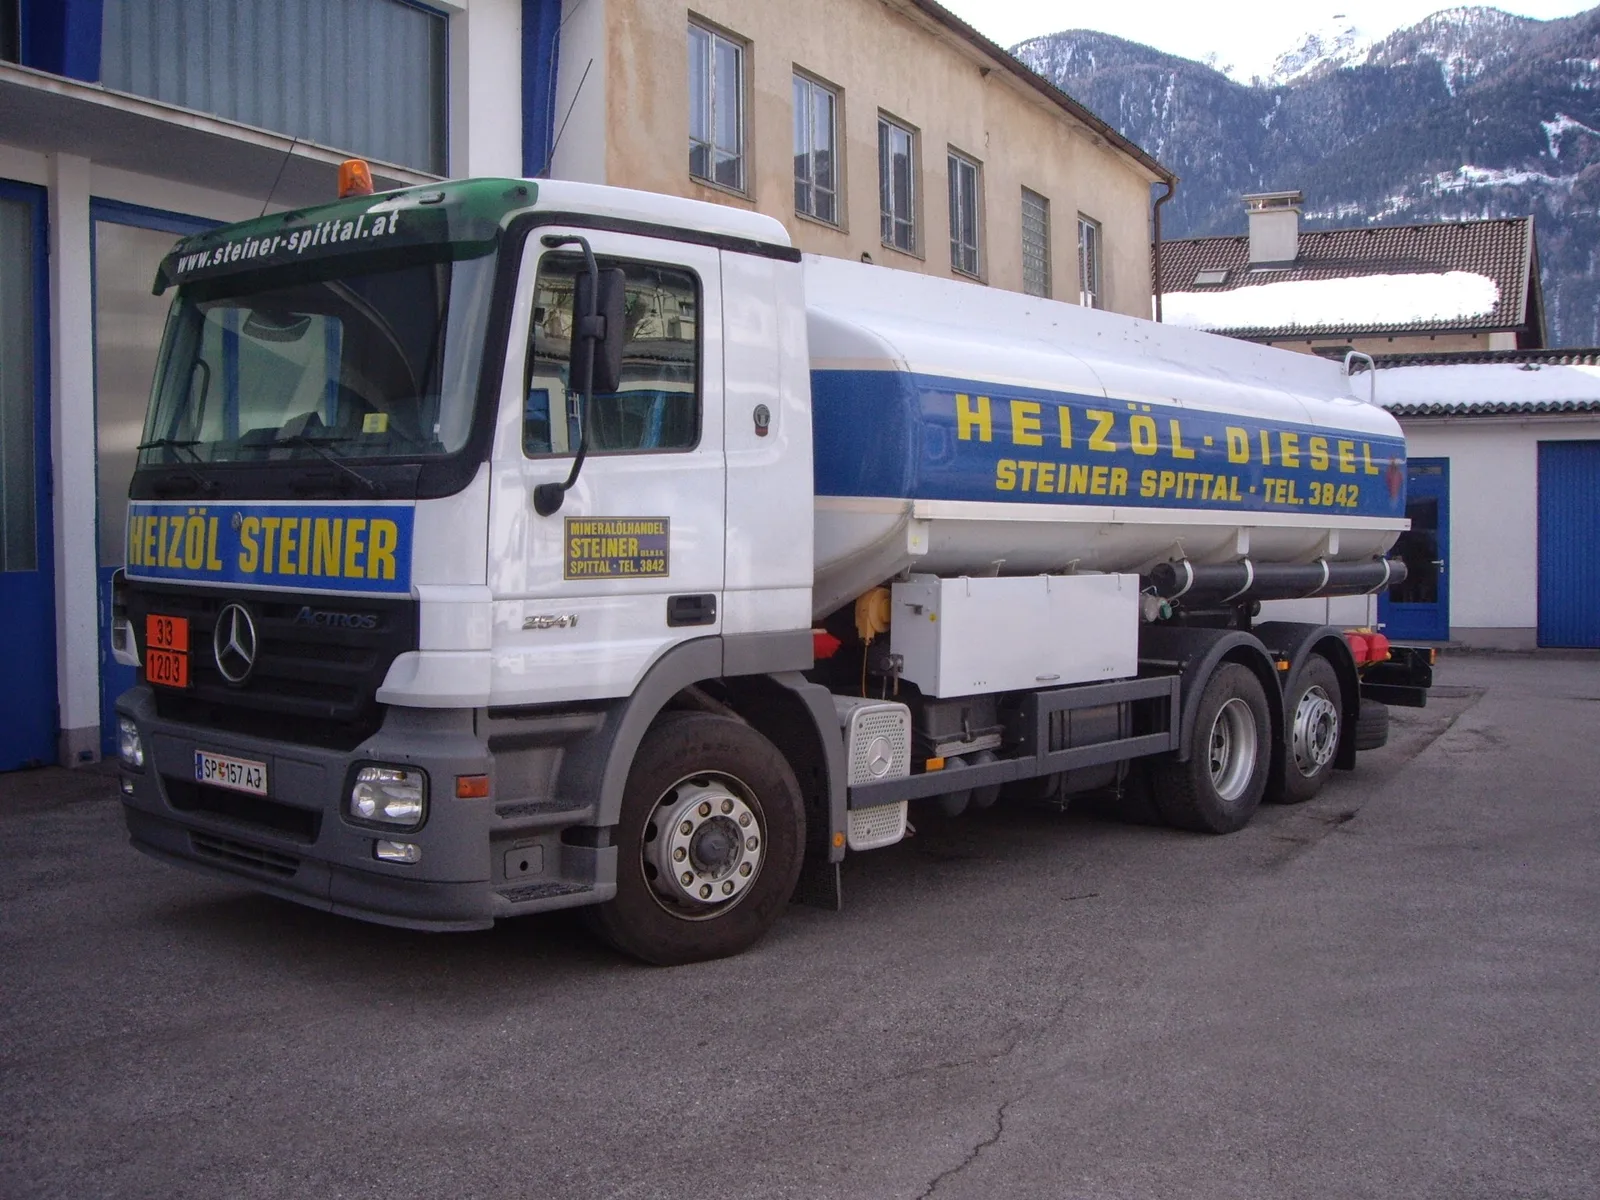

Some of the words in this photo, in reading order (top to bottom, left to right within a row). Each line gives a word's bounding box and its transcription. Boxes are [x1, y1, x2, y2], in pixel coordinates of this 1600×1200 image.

[177, 209, 399, 274] www.steiner-spittal.at
[955, 393, 1195, 459] HEIZÖL
[1226, 426, 1379, 475] DIESEL
[996, 459, 1128, 496] STEINER
[1140, 470, 1242, 501] SPITTAL
[1263, 478, 1303, 505] TEL.
[1309, 482, 1358, 507] 3842
[571, 521, 664, 535] MINERALÖLHANDEL
[128, 507, 223, 571] HEIZÖL
[238, 516, 398, 580] STEINER
[571, 538, 639, 558] STEINER
[570, 560, 611, 574] SPITTAL
[619, 560, 638, 573] TEL.
[640, 559, 664, 572] 3842
[157, 619, 173, 645] 33
[522, 614, 579, 631] 2541
[150, 655, 180, 682] 1203
[204, 759, 218, 778] SP
[226, 764, 243, 785] 157
